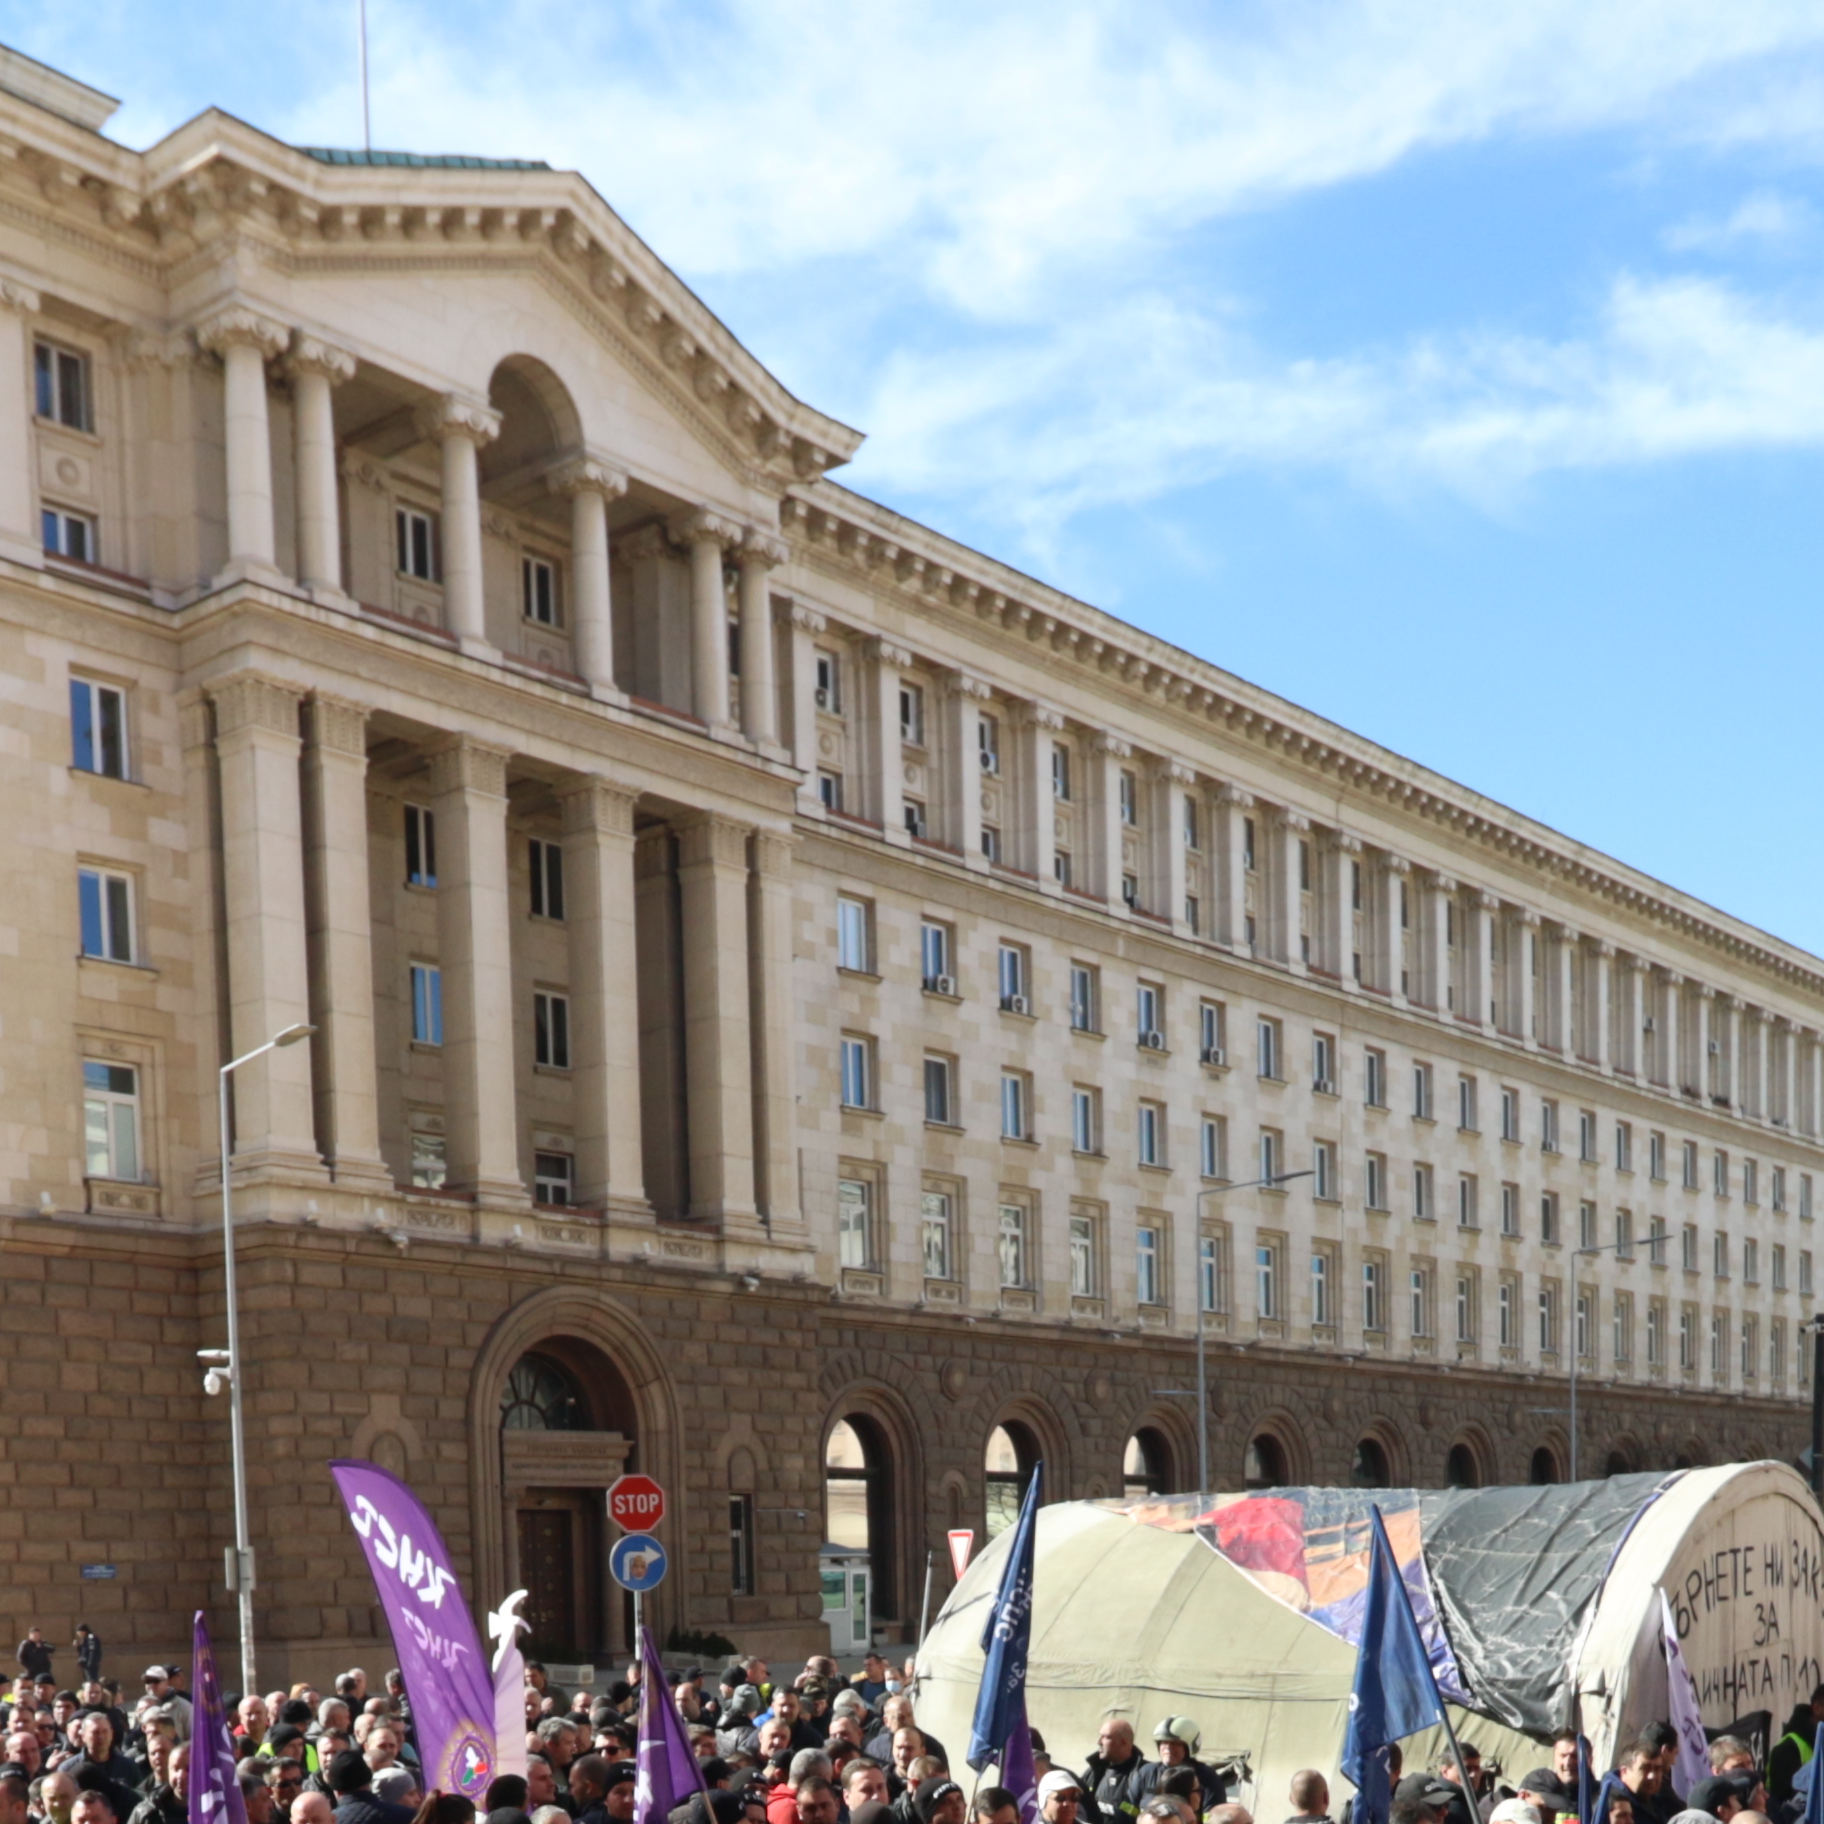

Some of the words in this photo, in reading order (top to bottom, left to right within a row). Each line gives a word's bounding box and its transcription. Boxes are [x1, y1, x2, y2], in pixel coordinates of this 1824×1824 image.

[614, 1493, 660, 1515] STOP
[1764, 1541, 1784, 1588] НИ
[1753, 1602, 1780, 1647] ЗА
